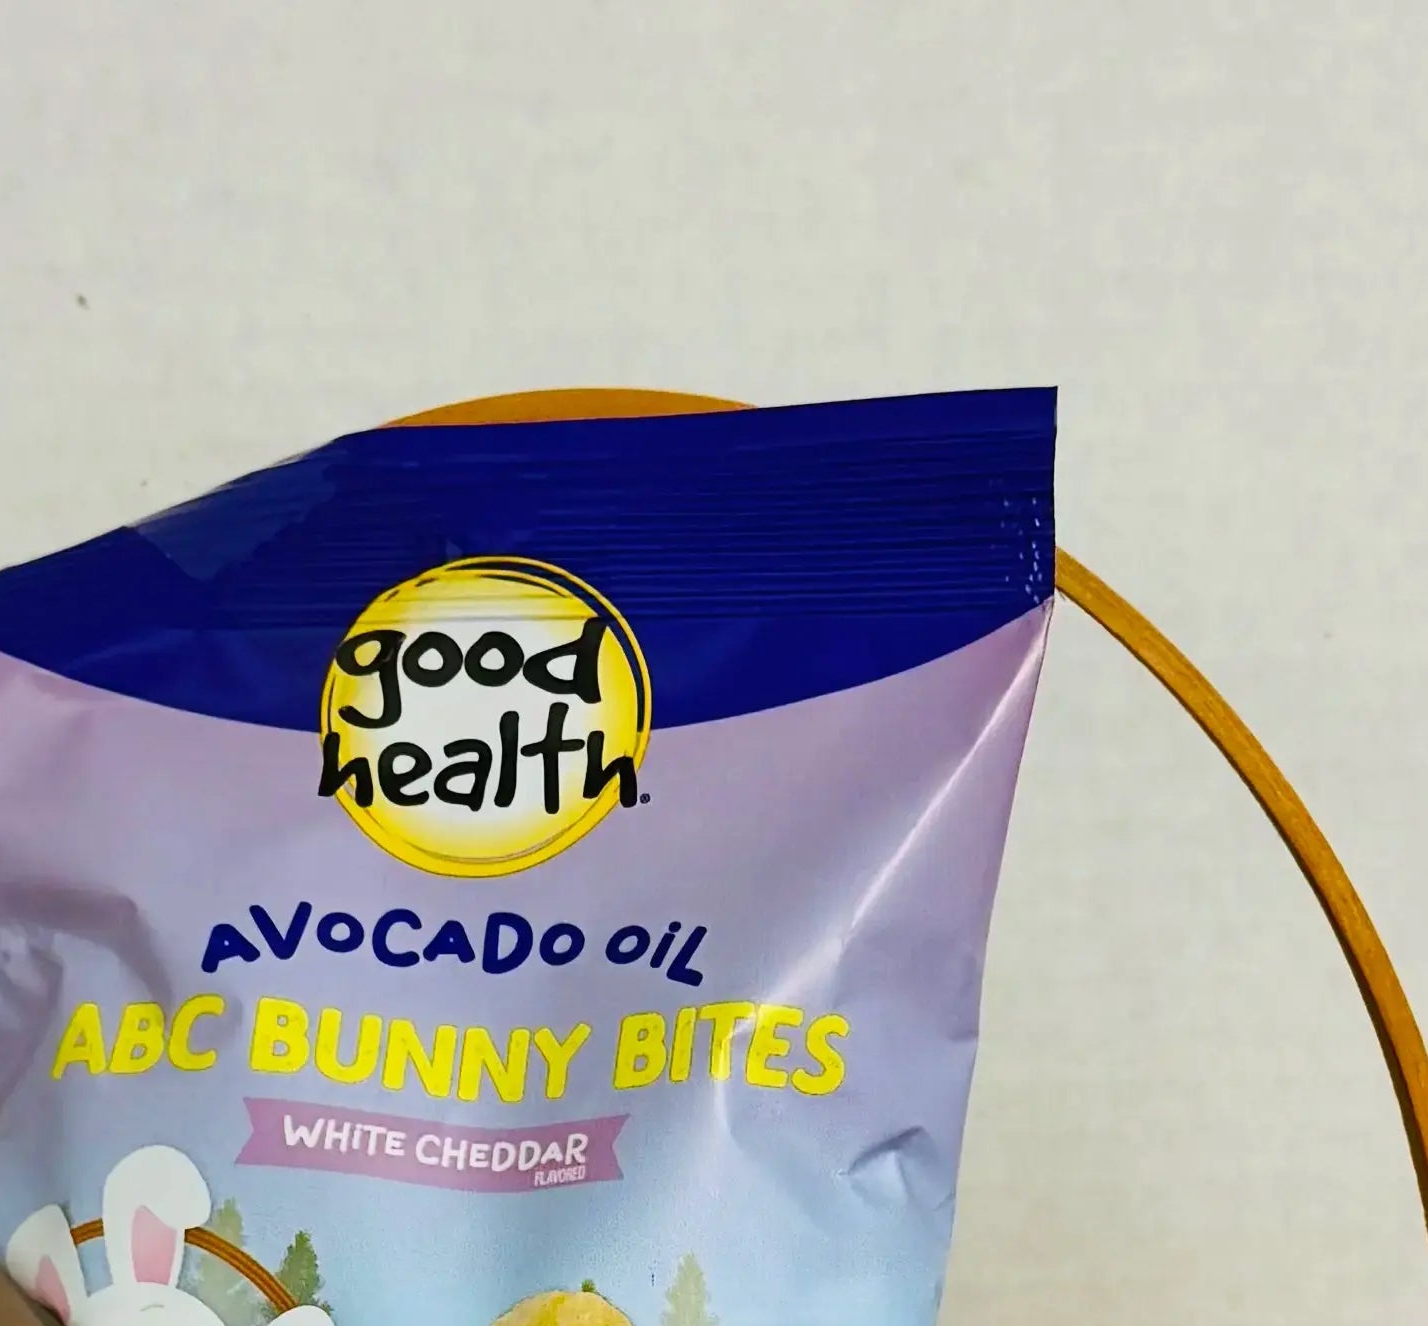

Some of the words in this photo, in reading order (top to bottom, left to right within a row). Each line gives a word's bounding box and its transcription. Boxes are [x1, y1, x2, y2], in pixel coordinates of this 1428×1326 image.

[333, 616, 605, 727] good
[318, 702, 640, 814] health
[201, 902, 585, 974] AVOCADO
[52, 996, 224, 1081] ABC
[248, 997, 591, 1101] BUNNY
[613, 1001, 851, 1096] BITES
[415, 1133, 588, 1172] CHEDDAR
